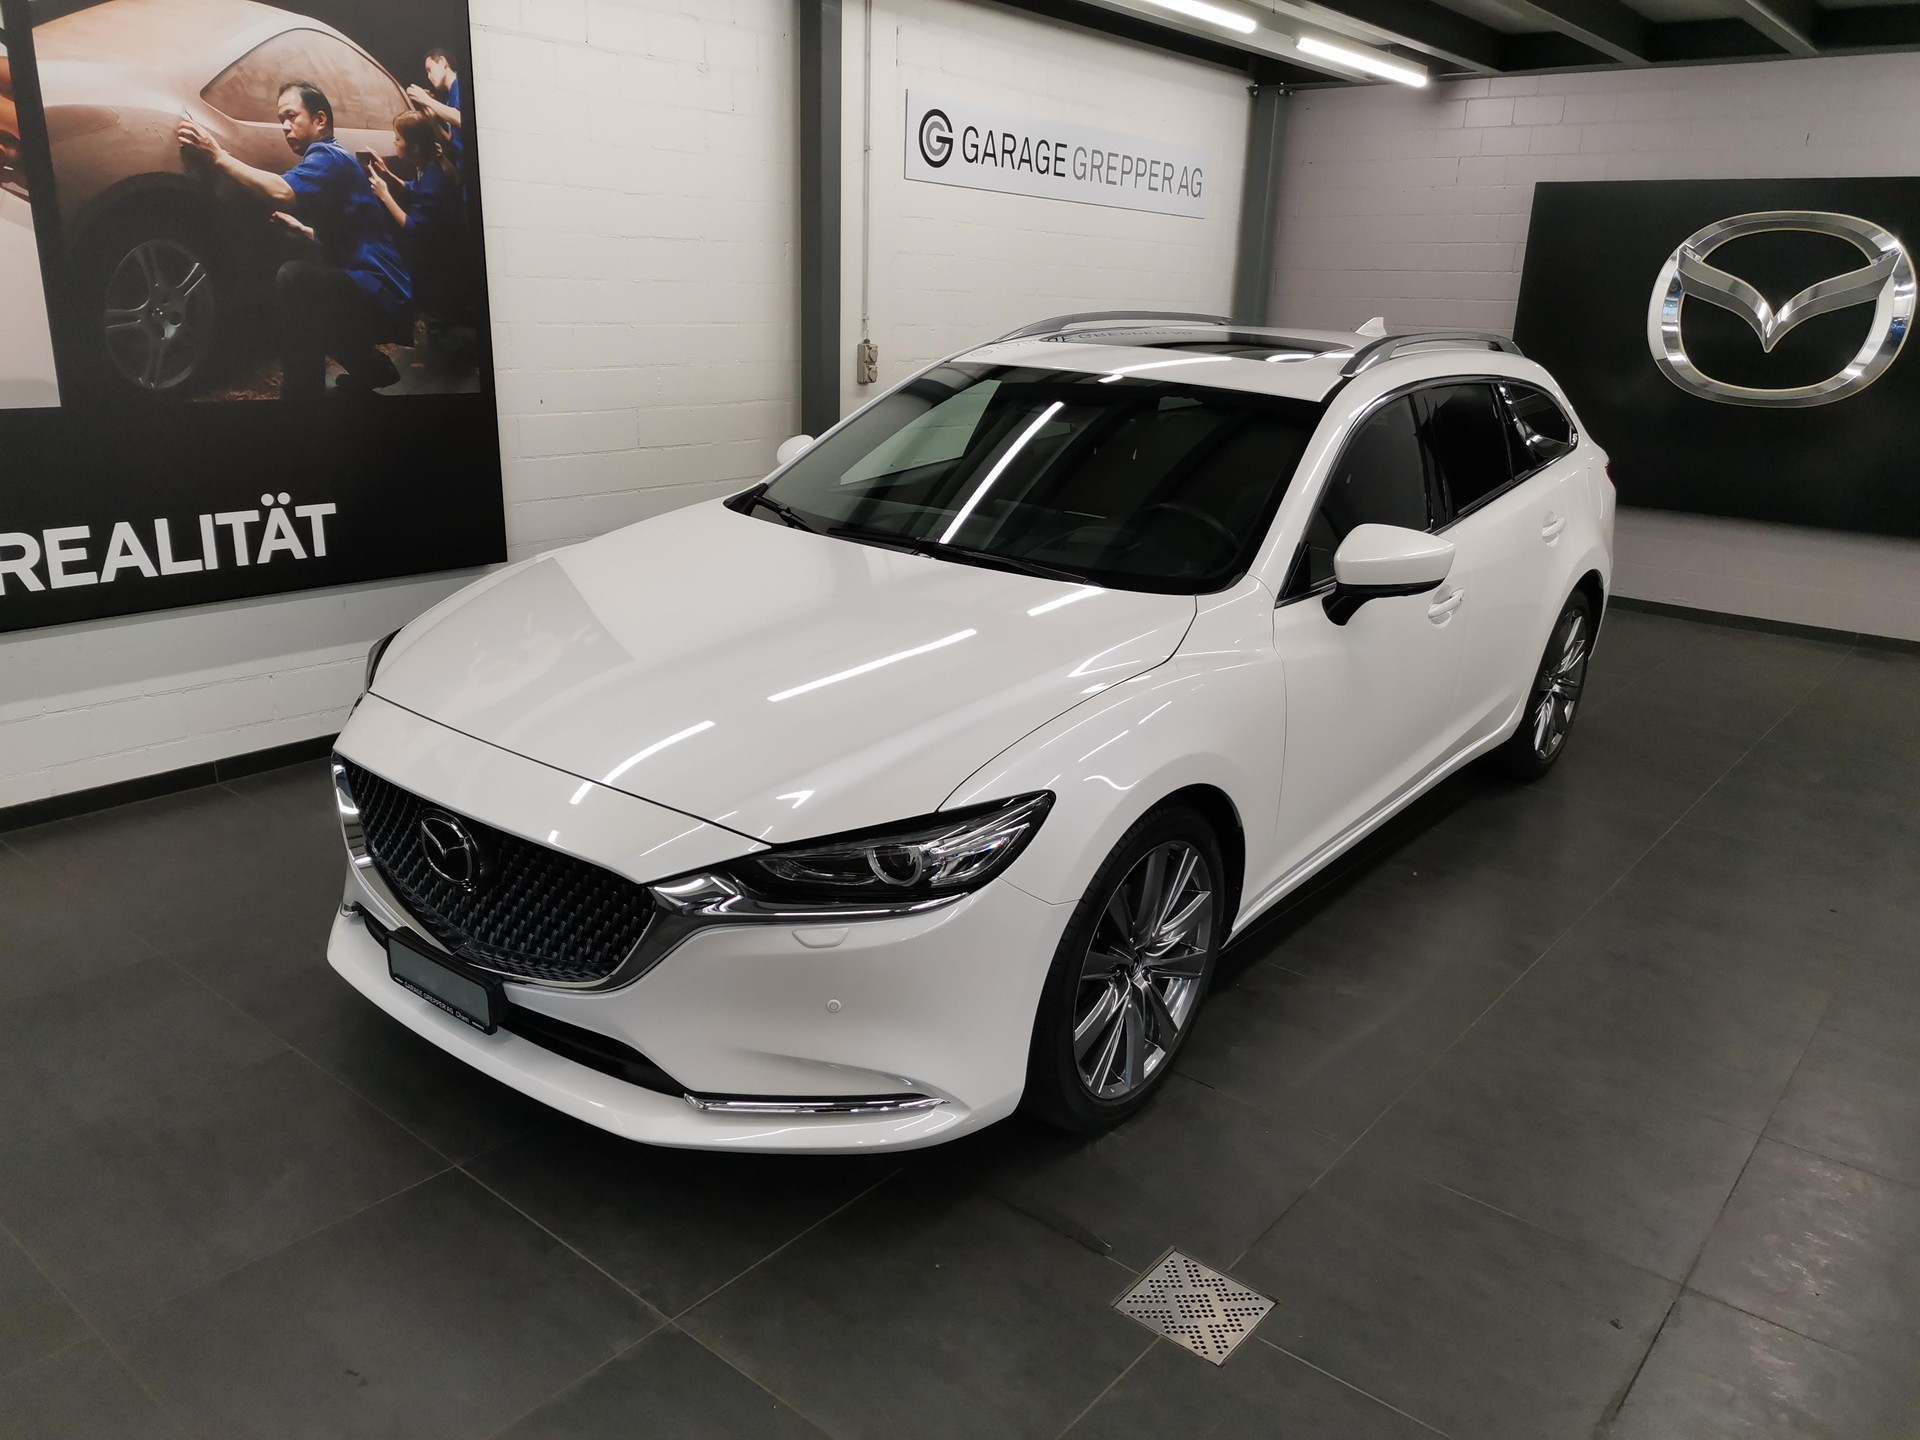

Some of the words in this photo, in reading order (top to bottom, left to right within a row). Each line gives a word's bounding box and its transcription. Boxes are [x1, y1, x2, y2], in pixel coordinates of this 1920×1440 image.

[962, 125, 1068, 178] GARAGE
[1072, 146, 1175, 194] GREPPER
[1177, 166, 1203, 199] AG
[0, 492, 337, 596] REALITÄT
[404, 981, 424, 997] GARAGE
[423, 992, 447, 1010] GREPPER
